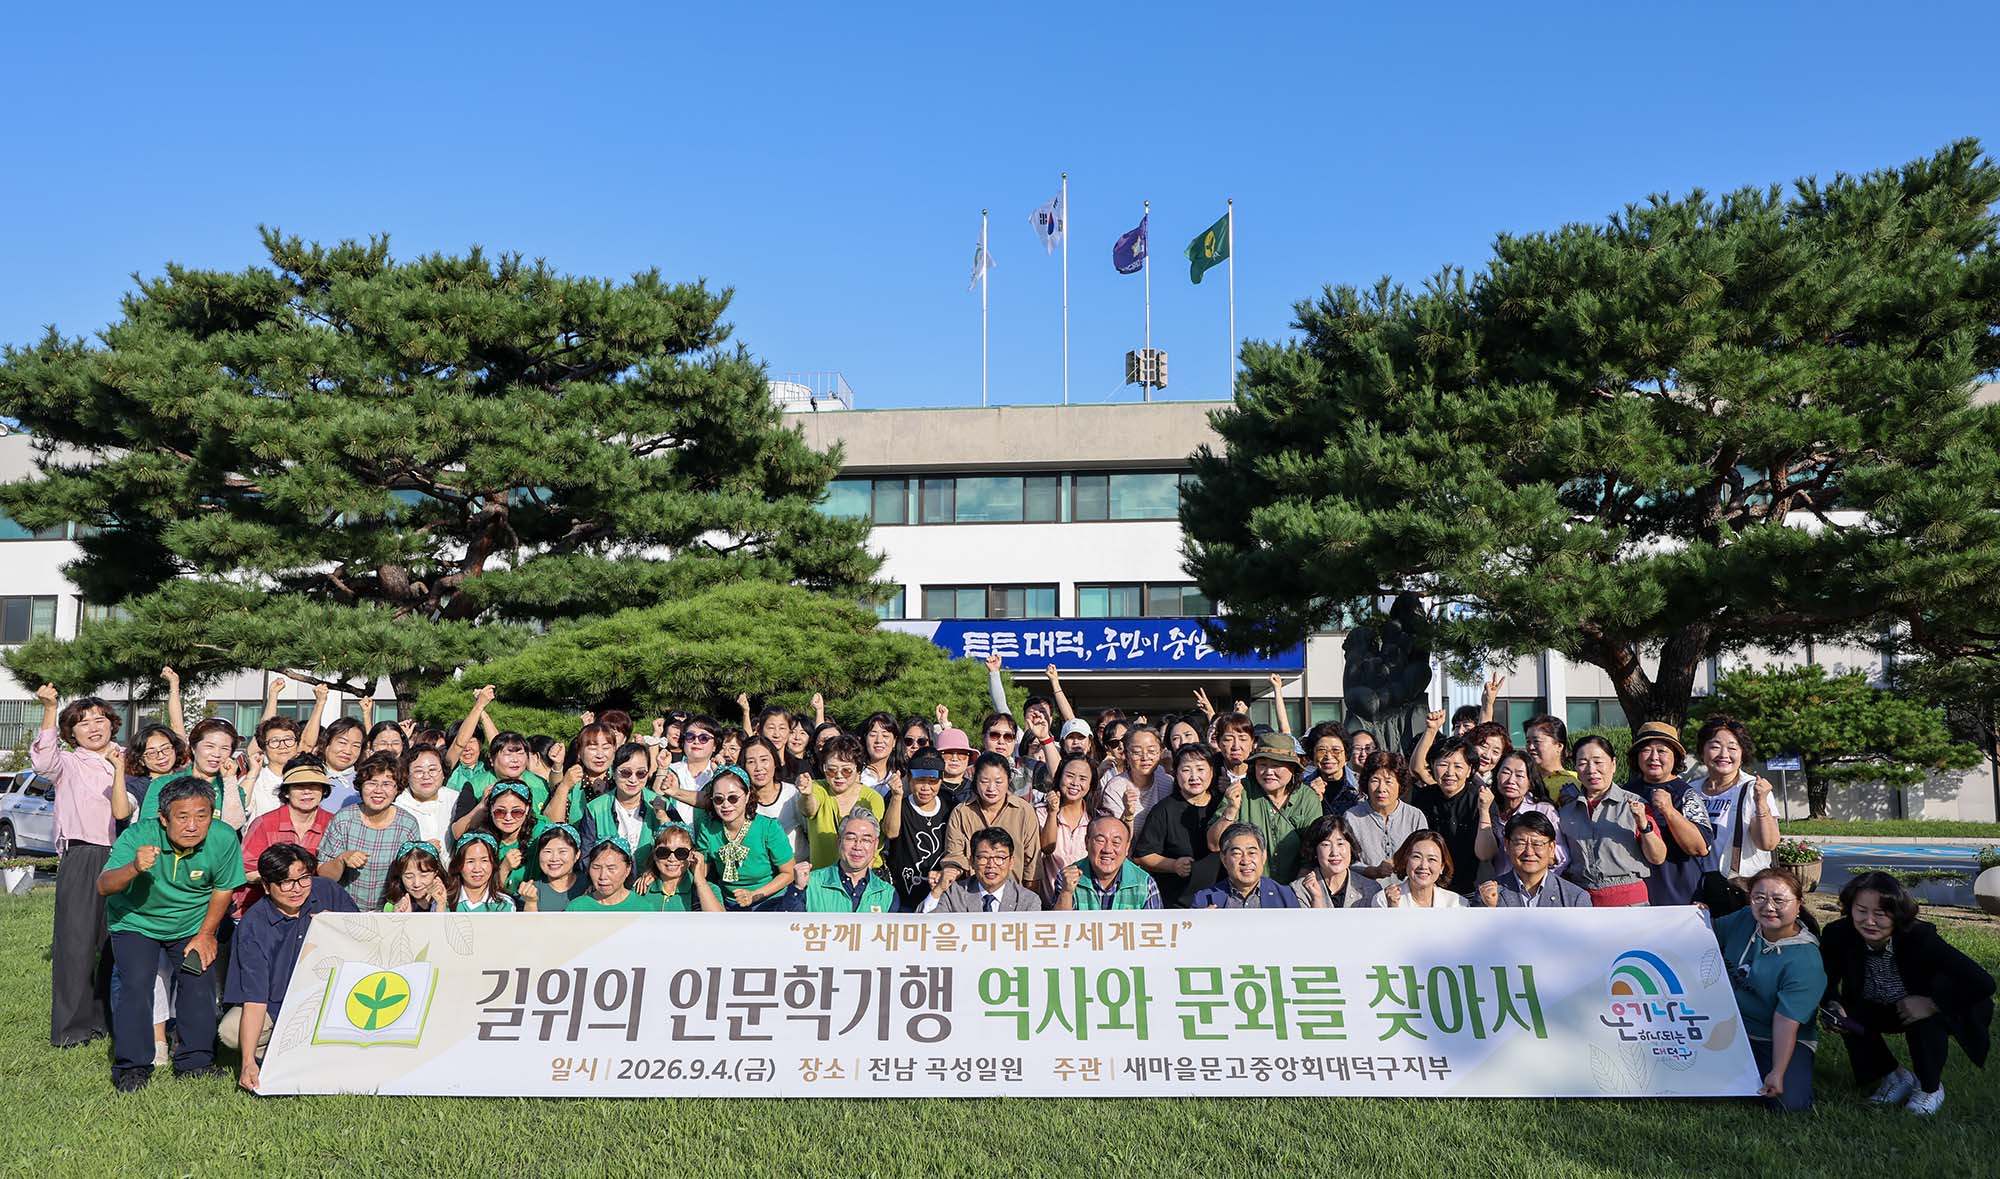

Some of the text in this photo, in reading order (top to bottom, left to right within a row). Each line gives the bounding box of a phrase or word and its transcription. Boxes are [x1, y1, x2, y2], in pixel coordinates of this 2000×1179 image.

[1023, 630, 1093, 662] 대덕,
[1096, 627, 1159, 663] 주민이
[790, 922, 861, 952] “함께
[476, 964, 1548, 1044] 길위의 인문학기행 역사와 문화를 찾아서
[1600, 1001, 1710, 1042] 온기나눔
[1638, 1029, 1686, 1045] 하나되는
[1652, 1047, 1693, 1061] 대덕구
[551, 1056, 1453, 1083] 일시 2026.9.4.(금) 장소 전남 곡성일원 주관 새마을문고중앙회대덕구지부
